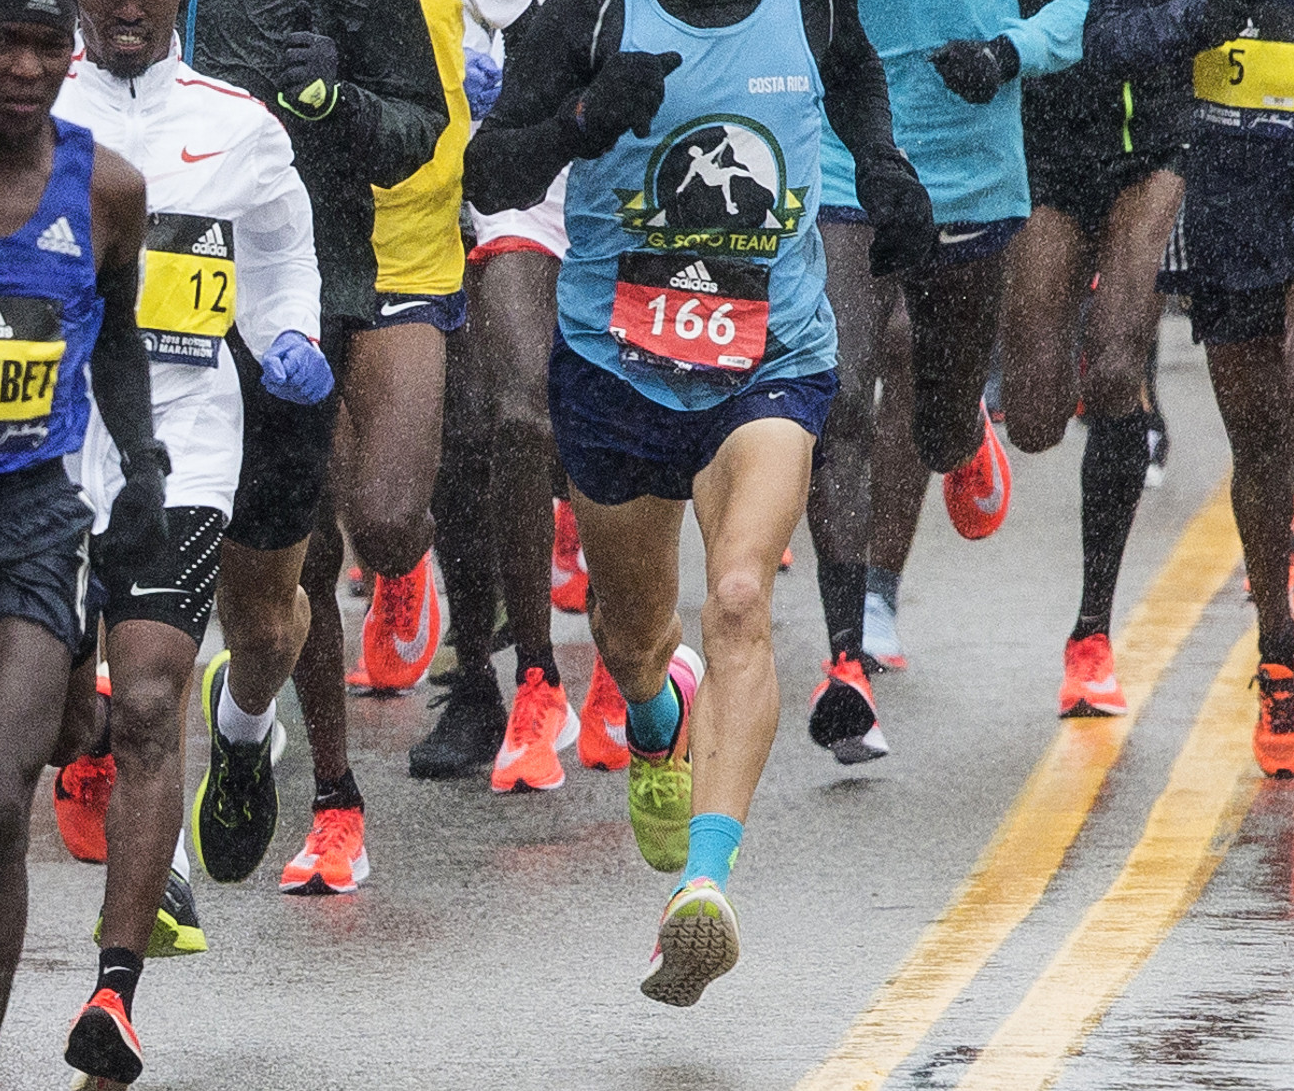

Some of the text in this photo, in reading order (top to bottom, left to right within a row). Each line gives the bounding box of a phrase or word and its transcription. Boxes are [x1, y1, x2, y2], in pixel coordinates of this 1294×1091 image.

[1228, 48, 1245, 86] 5
[748, 75, 810, 95] COSTA RICA
[648, 231, 667, 248] G.
[729, 234, 777, 251] TEAM
[190, 270, 228, 313] 12
[670, 275, 719, 294] adidas
[648, 294, 736, 345] 166
[159, 345, 213, 358] MARATHON
